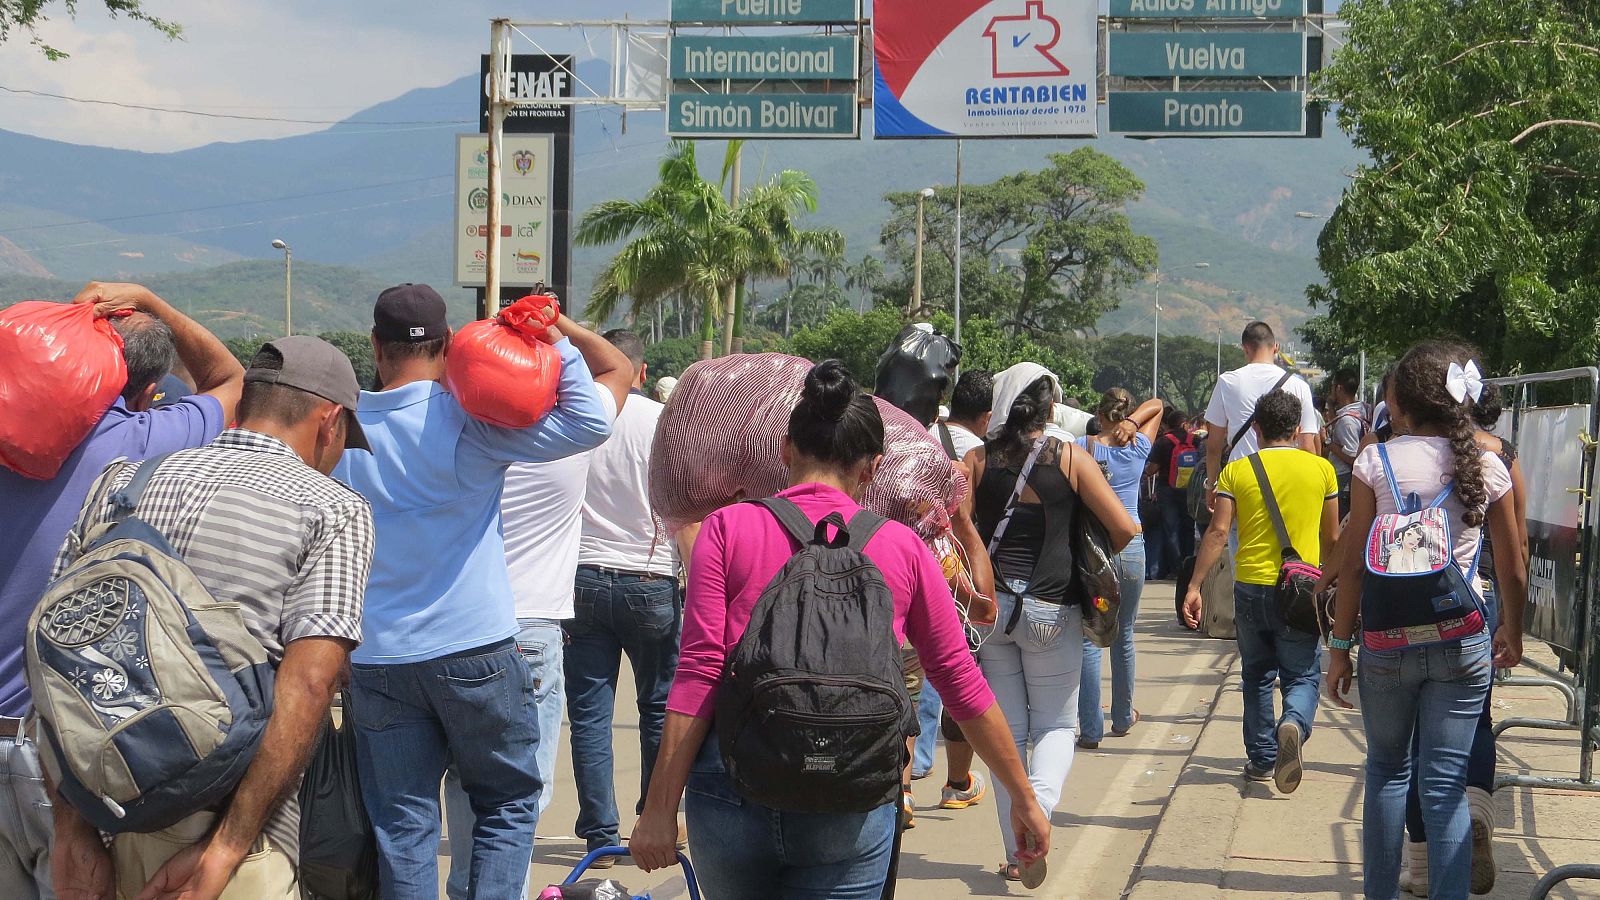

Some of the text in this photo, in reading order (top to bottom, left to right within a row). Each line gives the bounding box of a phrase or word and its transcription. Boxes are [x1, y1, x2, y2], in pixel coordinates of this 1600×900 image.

[685, 46, 834, 73] Internacional
[1165, 42, 1245, 71] Vuelva
[965, 83, 1087, 105] RENTABIEN
[681, 100, 752, 128] Simón
[967, 105, 1086, 117] Inmobiliarios desde 1978
[1164, 98, 1243, 127] Pronto
[517, 224, 533, 238] ica
